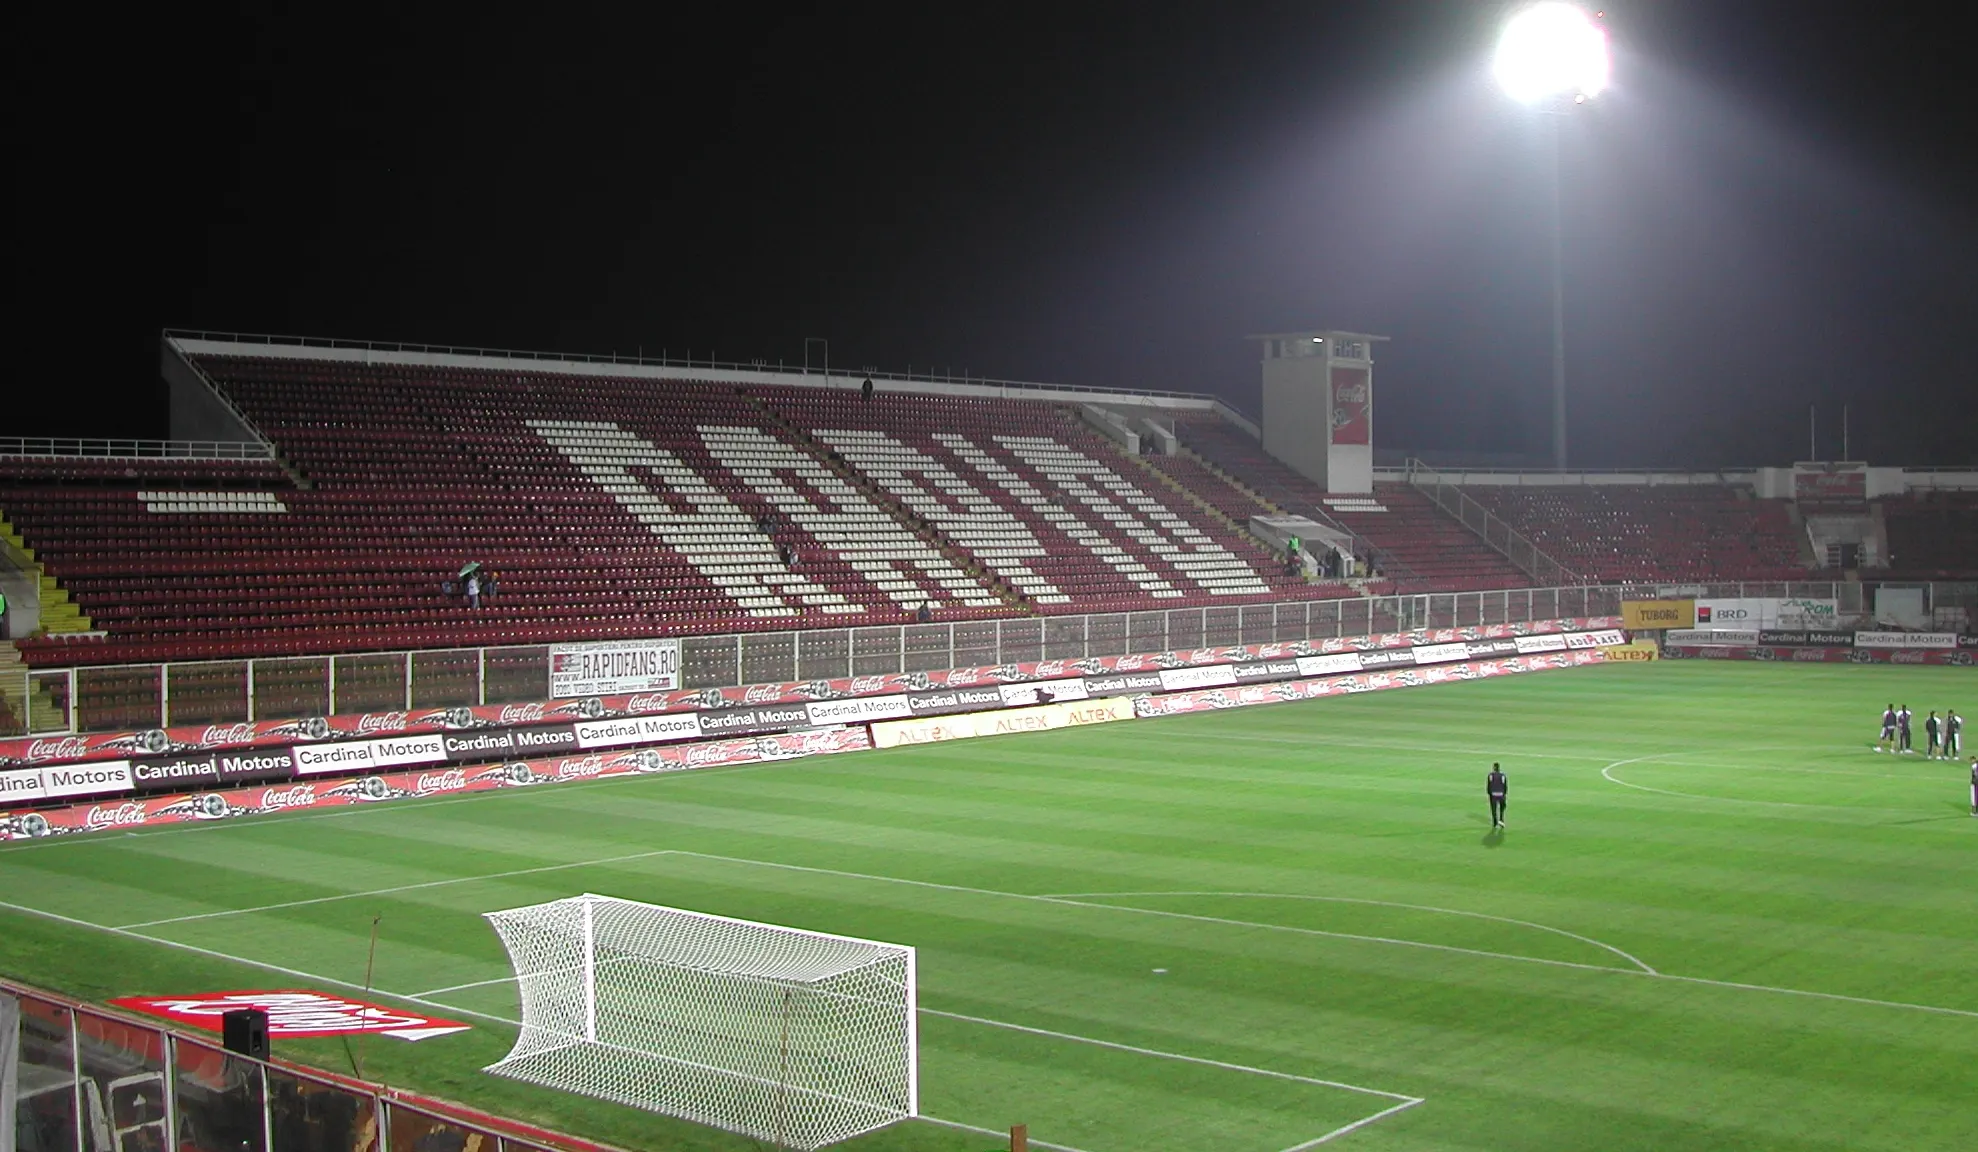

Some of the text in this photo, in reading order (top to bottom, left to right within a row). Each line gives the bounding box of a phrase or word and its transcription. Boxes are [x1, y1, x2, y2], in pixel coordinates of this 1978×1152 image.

[1640, 610, 1679, 621] TUBORG
[1716, 609, 1748, 619] BRD
[1668, 632, 1755, 642] Cardinal Motors
[1760, 633, 1851, 643] Cardinal Motors
[1857, 634, 1952, 643] Cardinal Motors
[1234, 662, 1298, 677] Cardinal Motors
[1086, 676, 1161, 692] Cardinal Motors
[811, 699, 906, 718] Cardinal Motors
[910, 691, 999, 709] Cardinal Motors
[700, 709, 806, 729] Cardinal Motors
[580, 719, 696, 740] Cardinal Motors
[446, 730, 574, 752] Cardinal Motors
[300, 741, 440, 765] Cardinal Motors
[135, 754, 292, 780] Cardinal Motors
[52, 769, 126, 787] Motors
